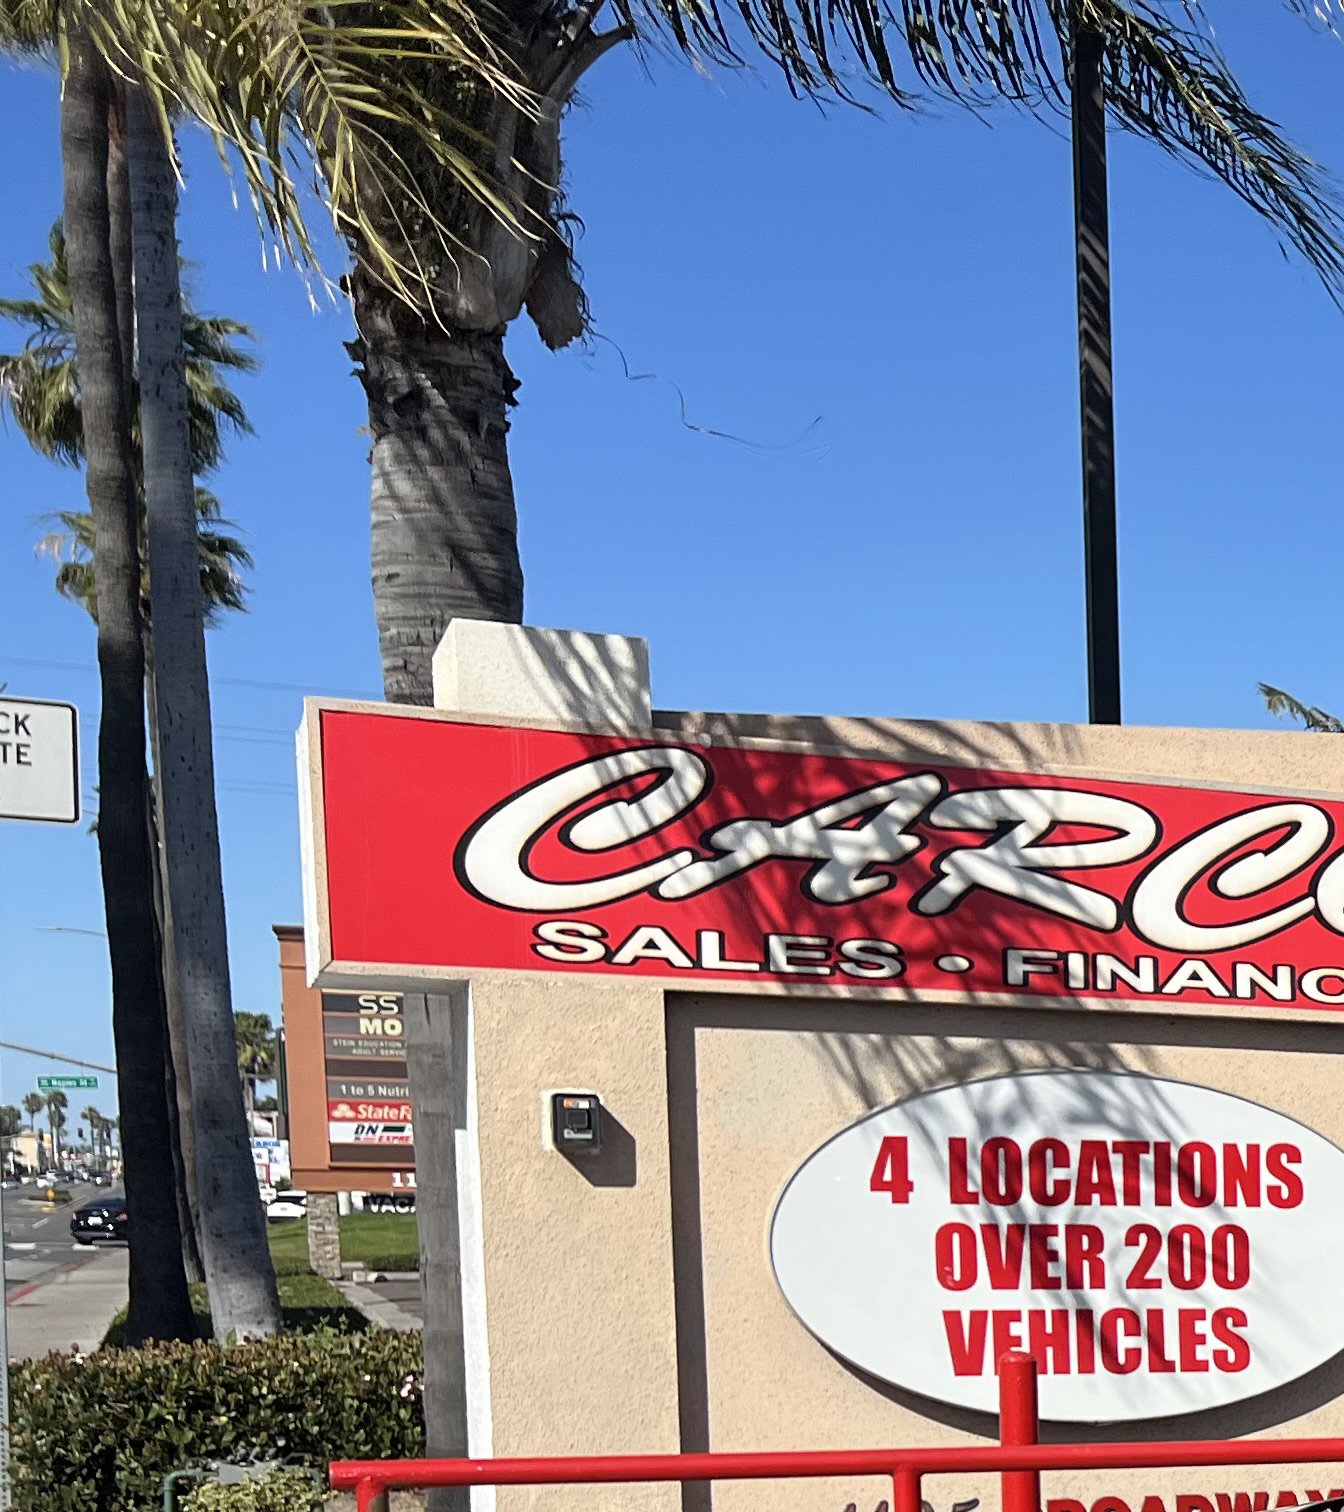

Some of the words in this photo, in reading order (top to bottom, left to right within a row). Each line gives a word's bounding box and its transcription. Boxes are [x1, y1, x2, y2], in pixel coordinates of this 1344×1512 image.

[531, 919, 904, 980] SALES
[340, 1084, 347, 1096] 1
[351, 1084, 364, 1096] to
[367, 1084, 375, 1097] 5
[869, 1135, 915, 1205] 4
[947, 1136, 1305, 1210] LOCATIONS
[934, 1221, 1106, 1292] OVER
[1124, 1222, 1251, 1290] 200
[941, 1306, 1252, 1377] VEHICLES
